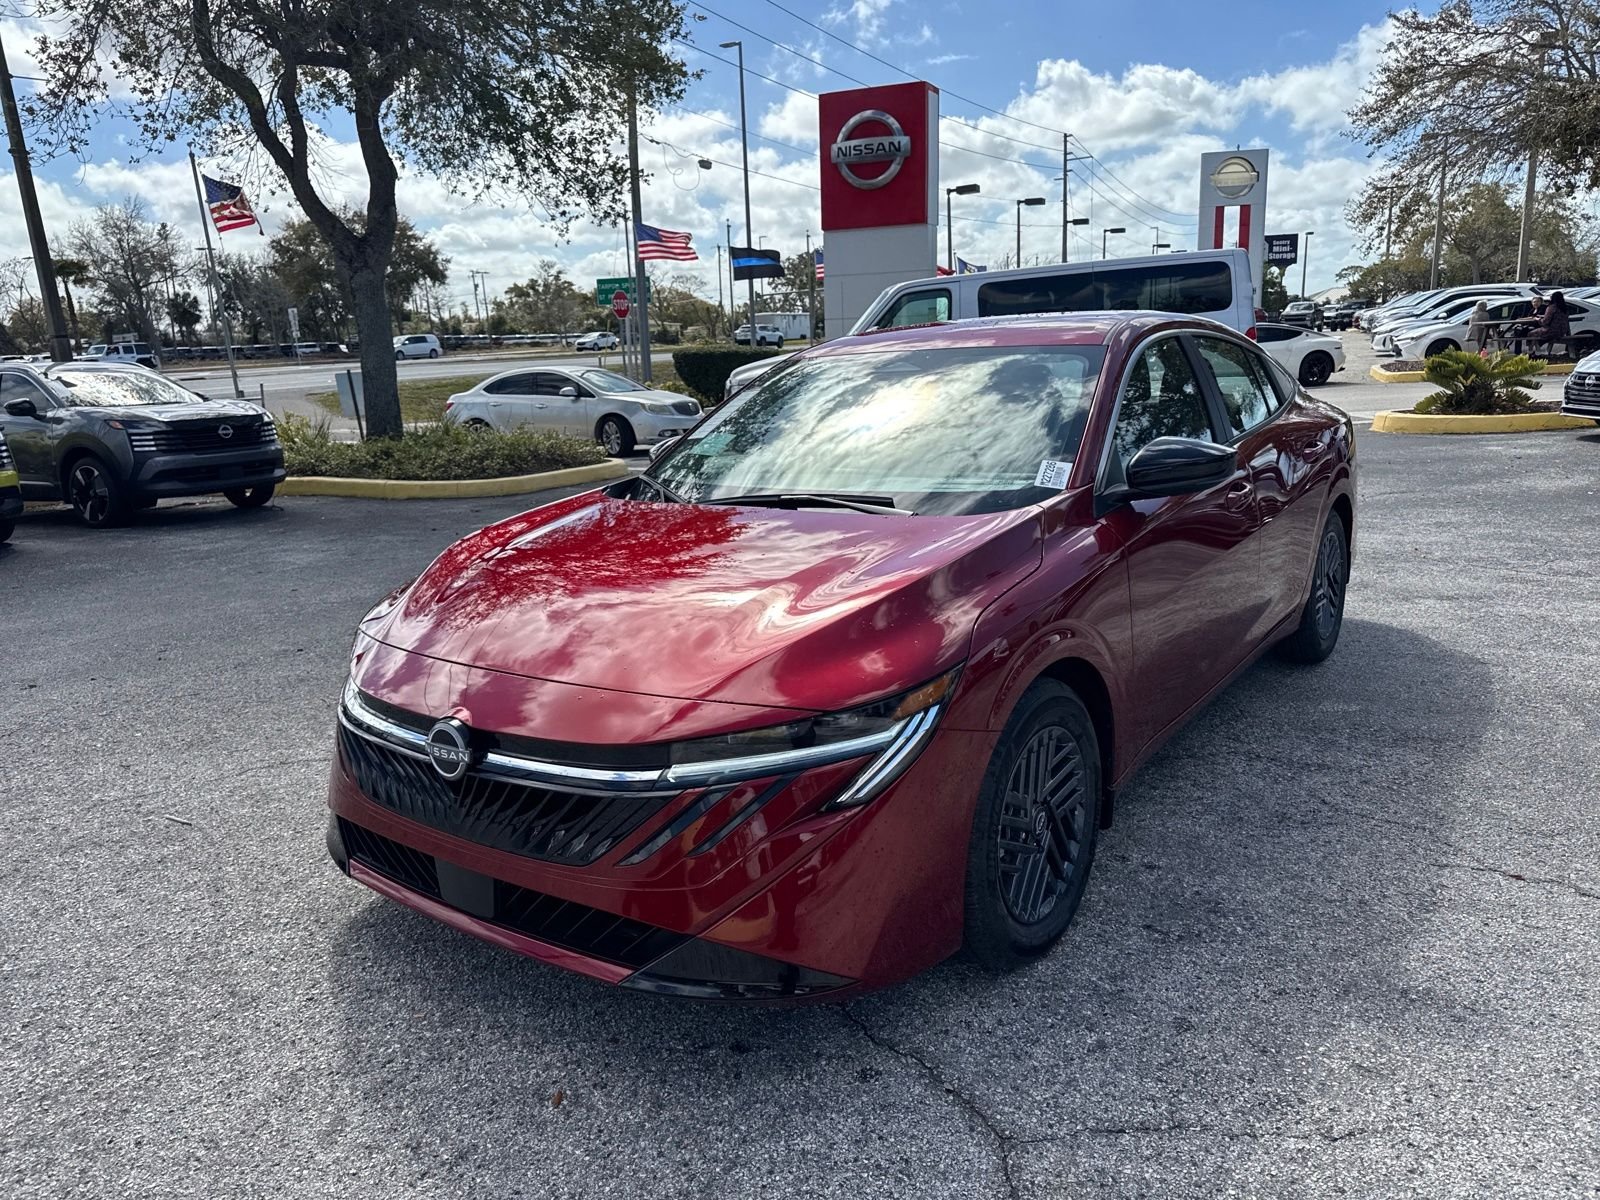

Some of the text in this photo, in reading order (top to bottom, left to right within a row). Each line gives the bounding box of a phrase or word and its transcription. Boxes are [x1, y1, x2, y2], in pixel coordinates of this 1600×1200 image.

[837, 141, 902, 158] NISSAN
[1268, 252, 1296, 260] Storage
[613, 299, 629, 310] STOP
